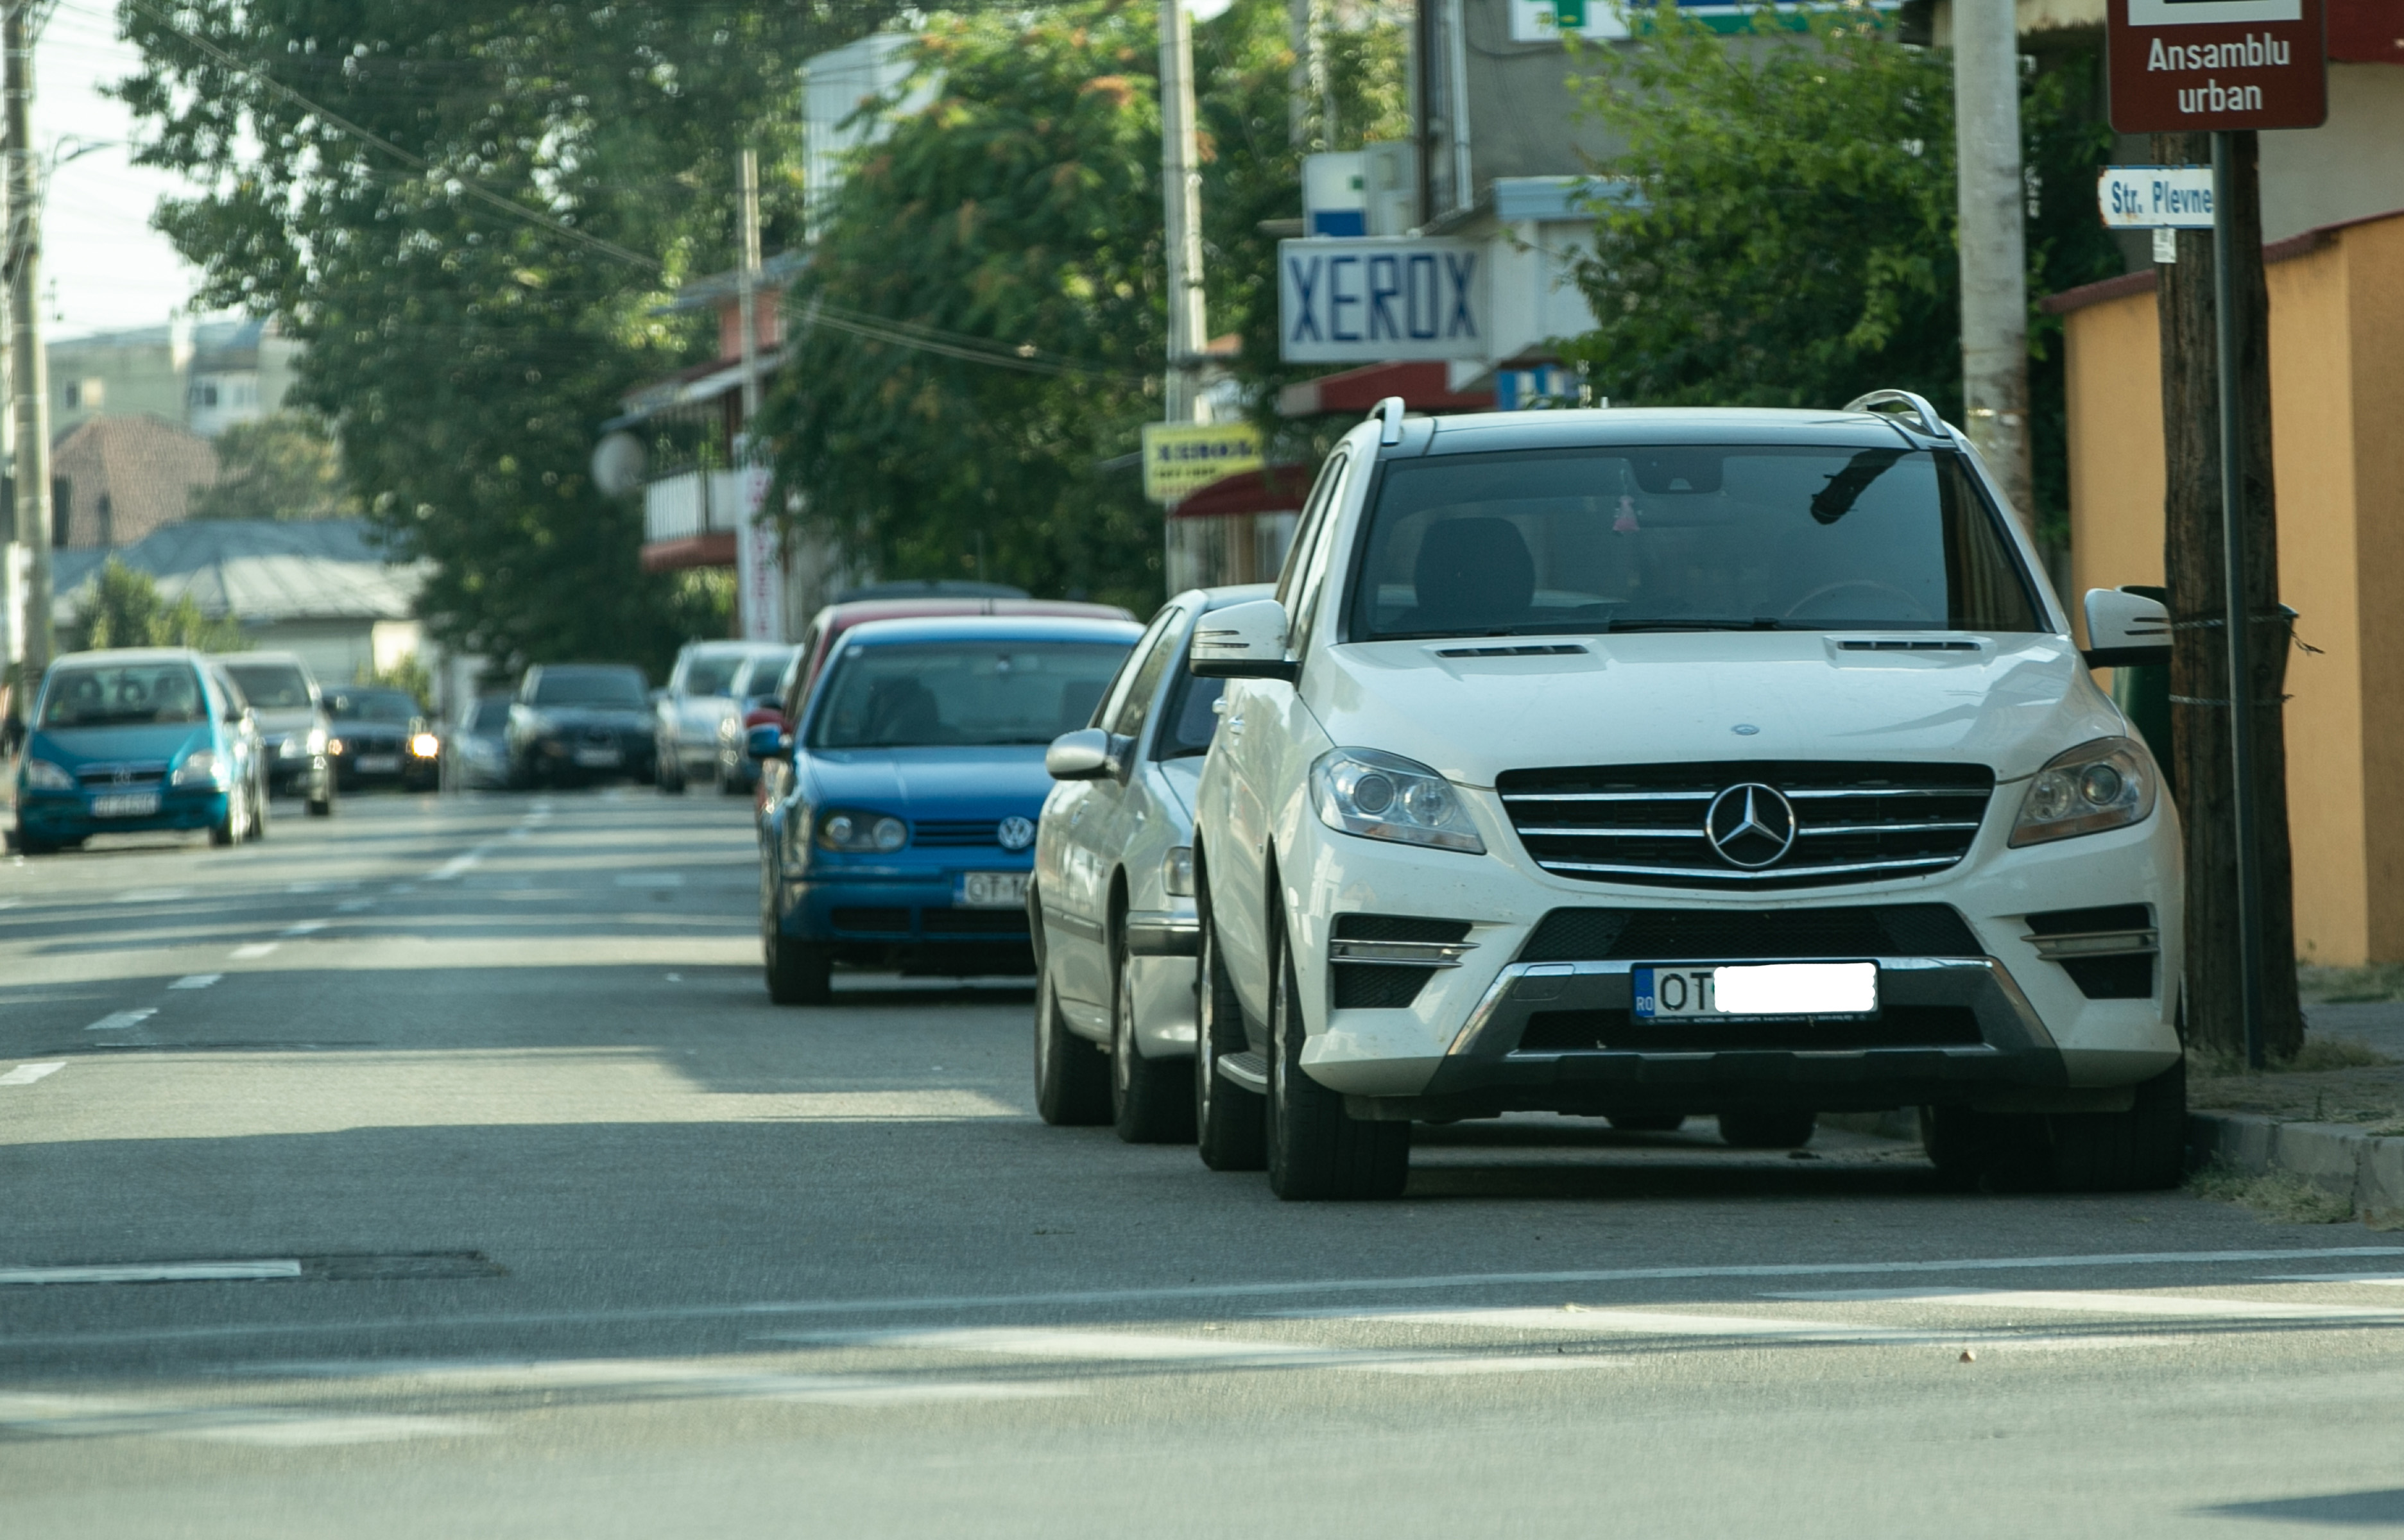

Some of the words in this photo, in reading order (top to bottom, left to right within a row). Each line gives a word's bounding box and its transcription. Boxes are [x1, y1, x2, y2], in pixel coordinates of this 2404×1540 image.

[2147, 33, 2290, 71] Ansamblu
[2178, 79, 2263, 113] urban
[2111, 180, 2143, 214] Str.
[2153, 180, 2213, 214] Plevne
[1289, 253, 1477, 343] XEROX
[1636, 996, 1654, 1012] RO
[1660, 972, 1712, 1012] OT
